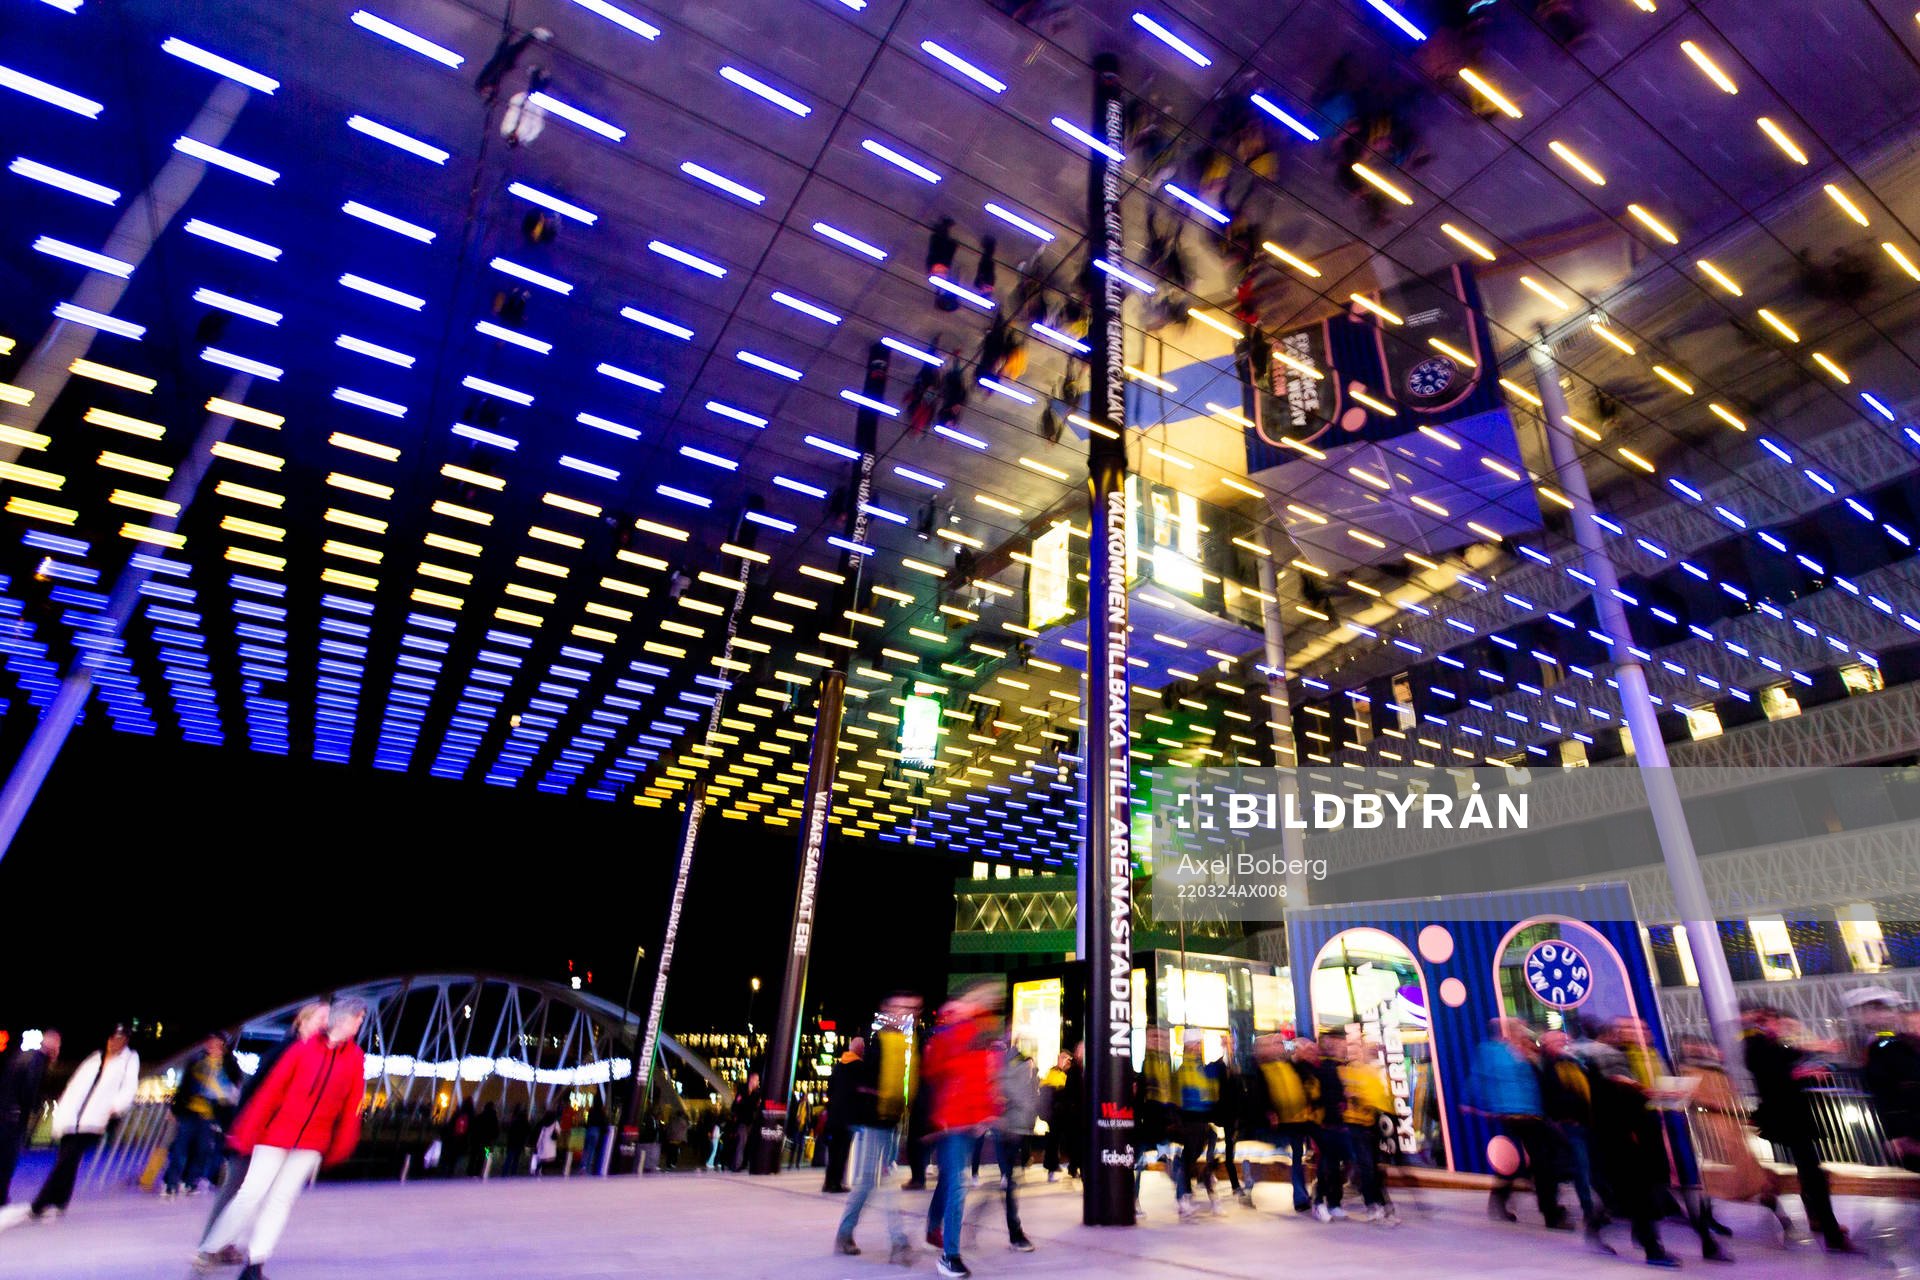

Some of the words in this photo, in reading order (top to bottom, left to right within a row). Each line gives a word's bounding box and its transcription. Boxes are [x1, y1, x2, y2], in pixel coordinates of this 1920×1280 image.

[1108, 631, 1127, 749] TILLBAKA
[1109, 756, 1130, 813] TILL
[809, 808, 826, 846] HAR
[798, 846, 820, 922] SAKNAT
[793, 923, 811, 957] ER!
[1109, 816, 1131, 1058] ARENASTADEN!
